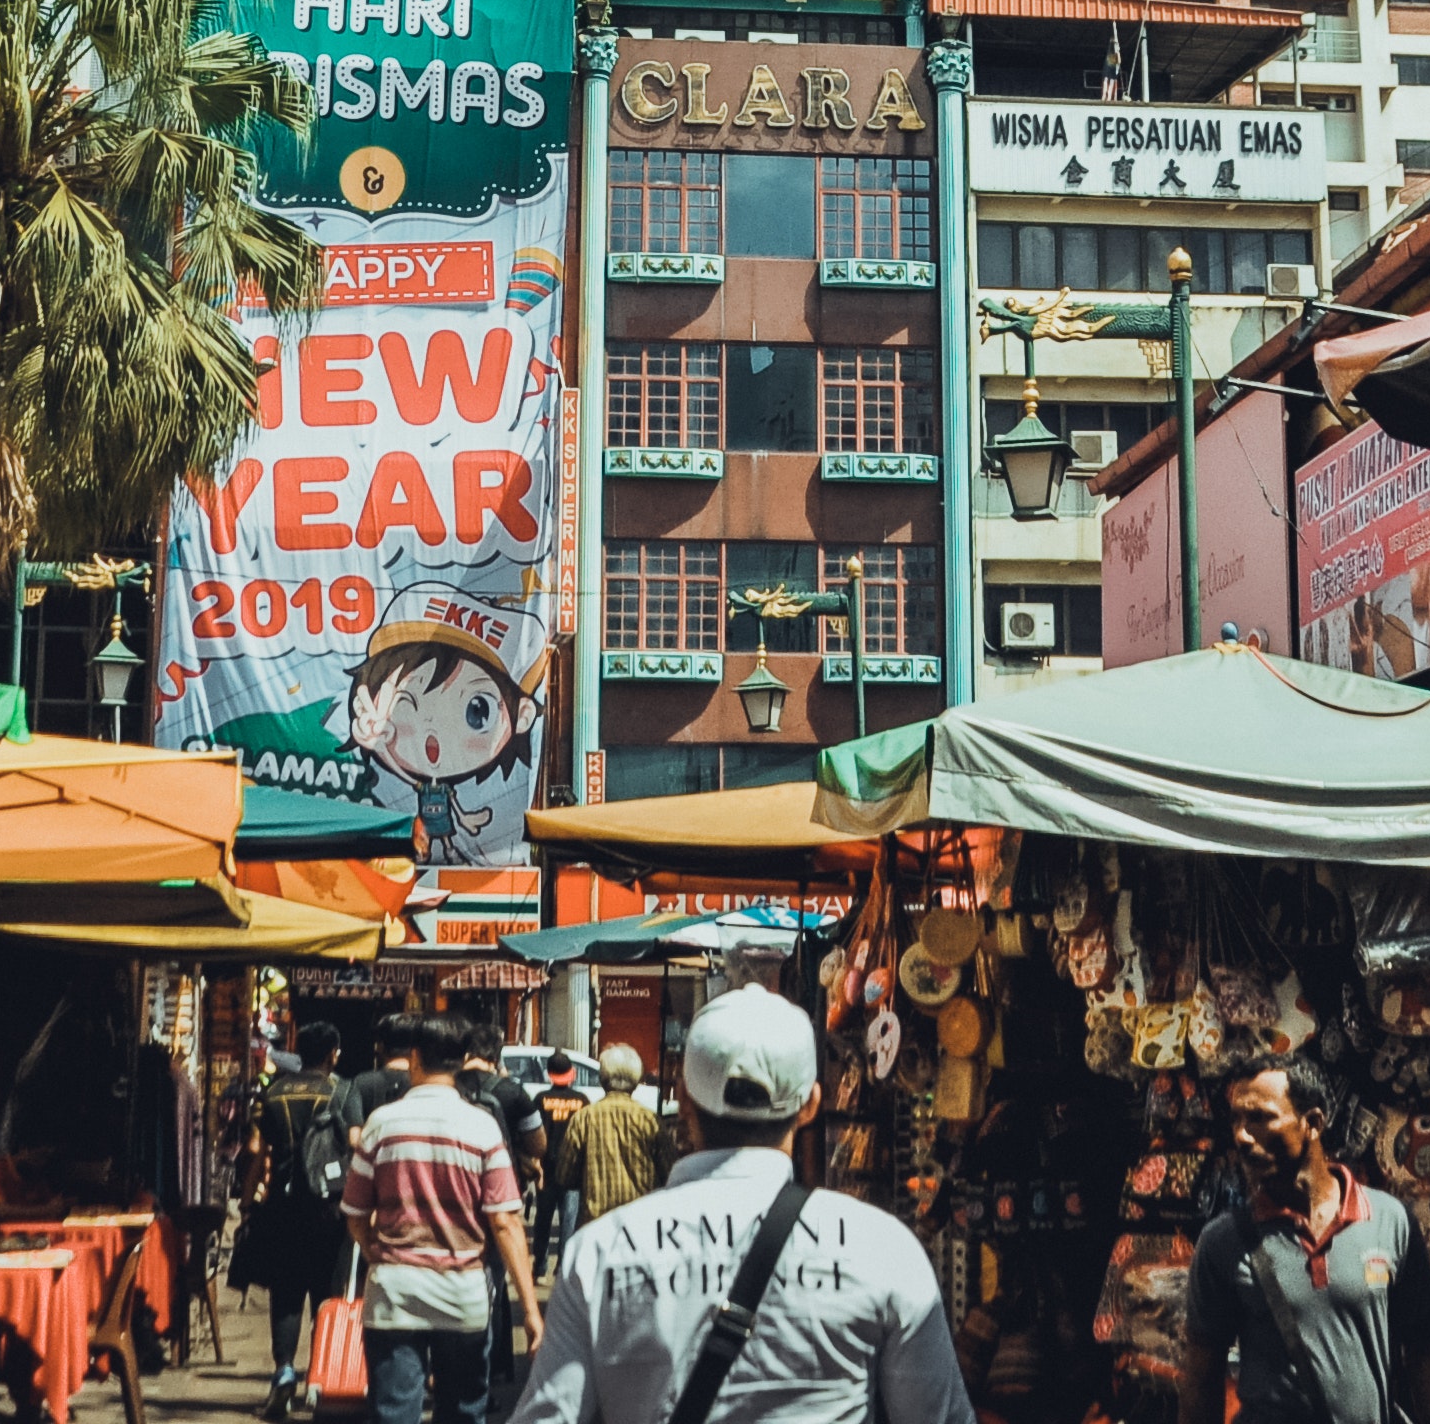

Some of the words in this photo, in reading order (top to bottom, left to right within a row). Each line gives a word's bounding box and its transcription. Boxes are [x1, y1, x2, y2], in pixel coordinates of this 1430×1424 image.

[622, 60, 926, 131] CLARA
[992, 113, 1068, 148] WISMA
[1087, 116, 1221, 152] PERSATUAN
[1240, 120, 1302, 154] EMAS
[326, 255, 446, 290] APPY
[184, 450, 538, 555] YEAR
[561, 443, 576, 539] SUPER
[191, 575, 375, 639] 2019
[560, 552, 575, 629] MART
[444, 602, 492, 639] KK
[187, 740, 365, 791] LAMAT
[803, 895, 853, 918] BA
[441, 922, 489, 942] SUPER
[605, 988, 650, 998] BANKING
[605, 1262, 842, 1298] EXCHGE
